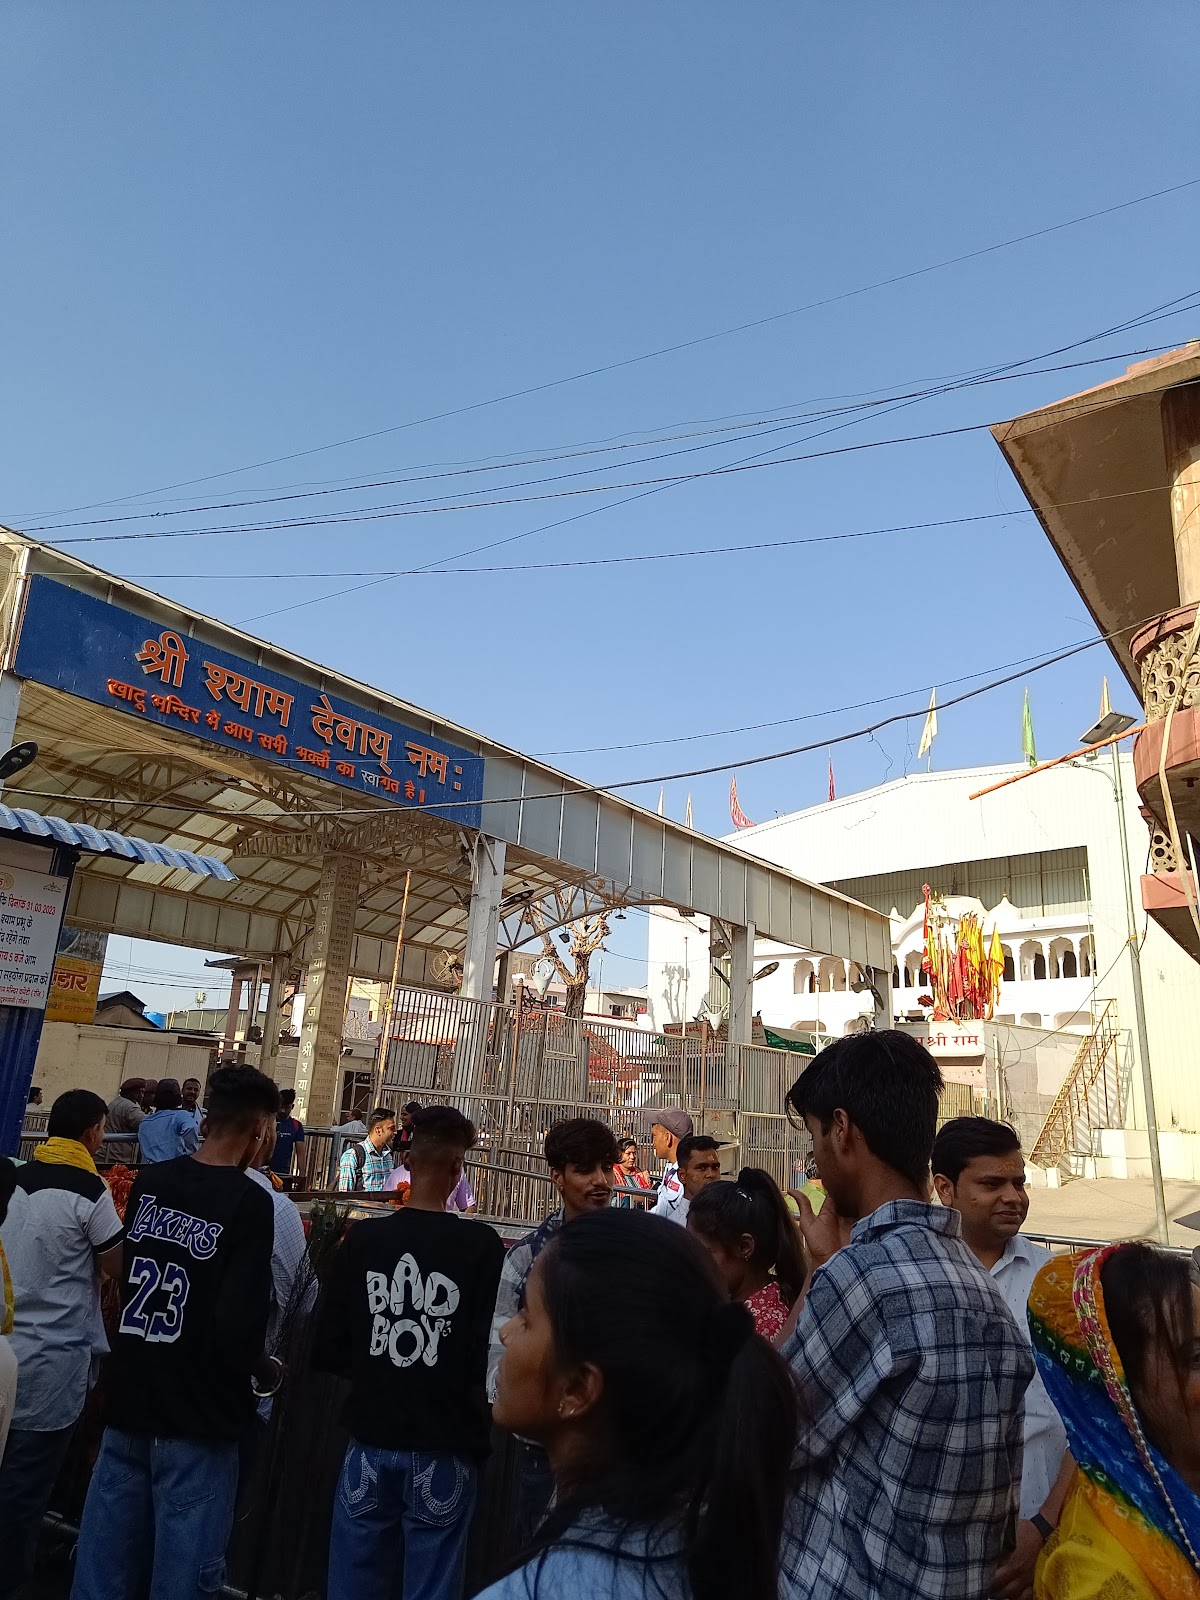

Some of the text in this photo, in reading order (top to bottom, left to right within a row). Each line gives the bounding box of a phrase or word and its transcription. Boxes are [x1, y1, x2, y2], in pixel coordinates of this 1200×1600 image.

[135, 631, 189, 687] श्री
[203, 661, 294, 727] श्याम
[107, 678, 147, 712] खाटू
[151, 694, 201, 724] मन्दिर
[223, 720, 254, 743] आप
[336, 761, 355, 778] का
[361, 769, 400, 793] स्वागत
[927, 1032, 948, 1046] श्री
[951, 1035, 979, 1046] राम
[127, 1194, 224, 1260] LAKERS
[119, 1256, 190, 1343] 23
[366, 1252, 460, 1316] BAD
